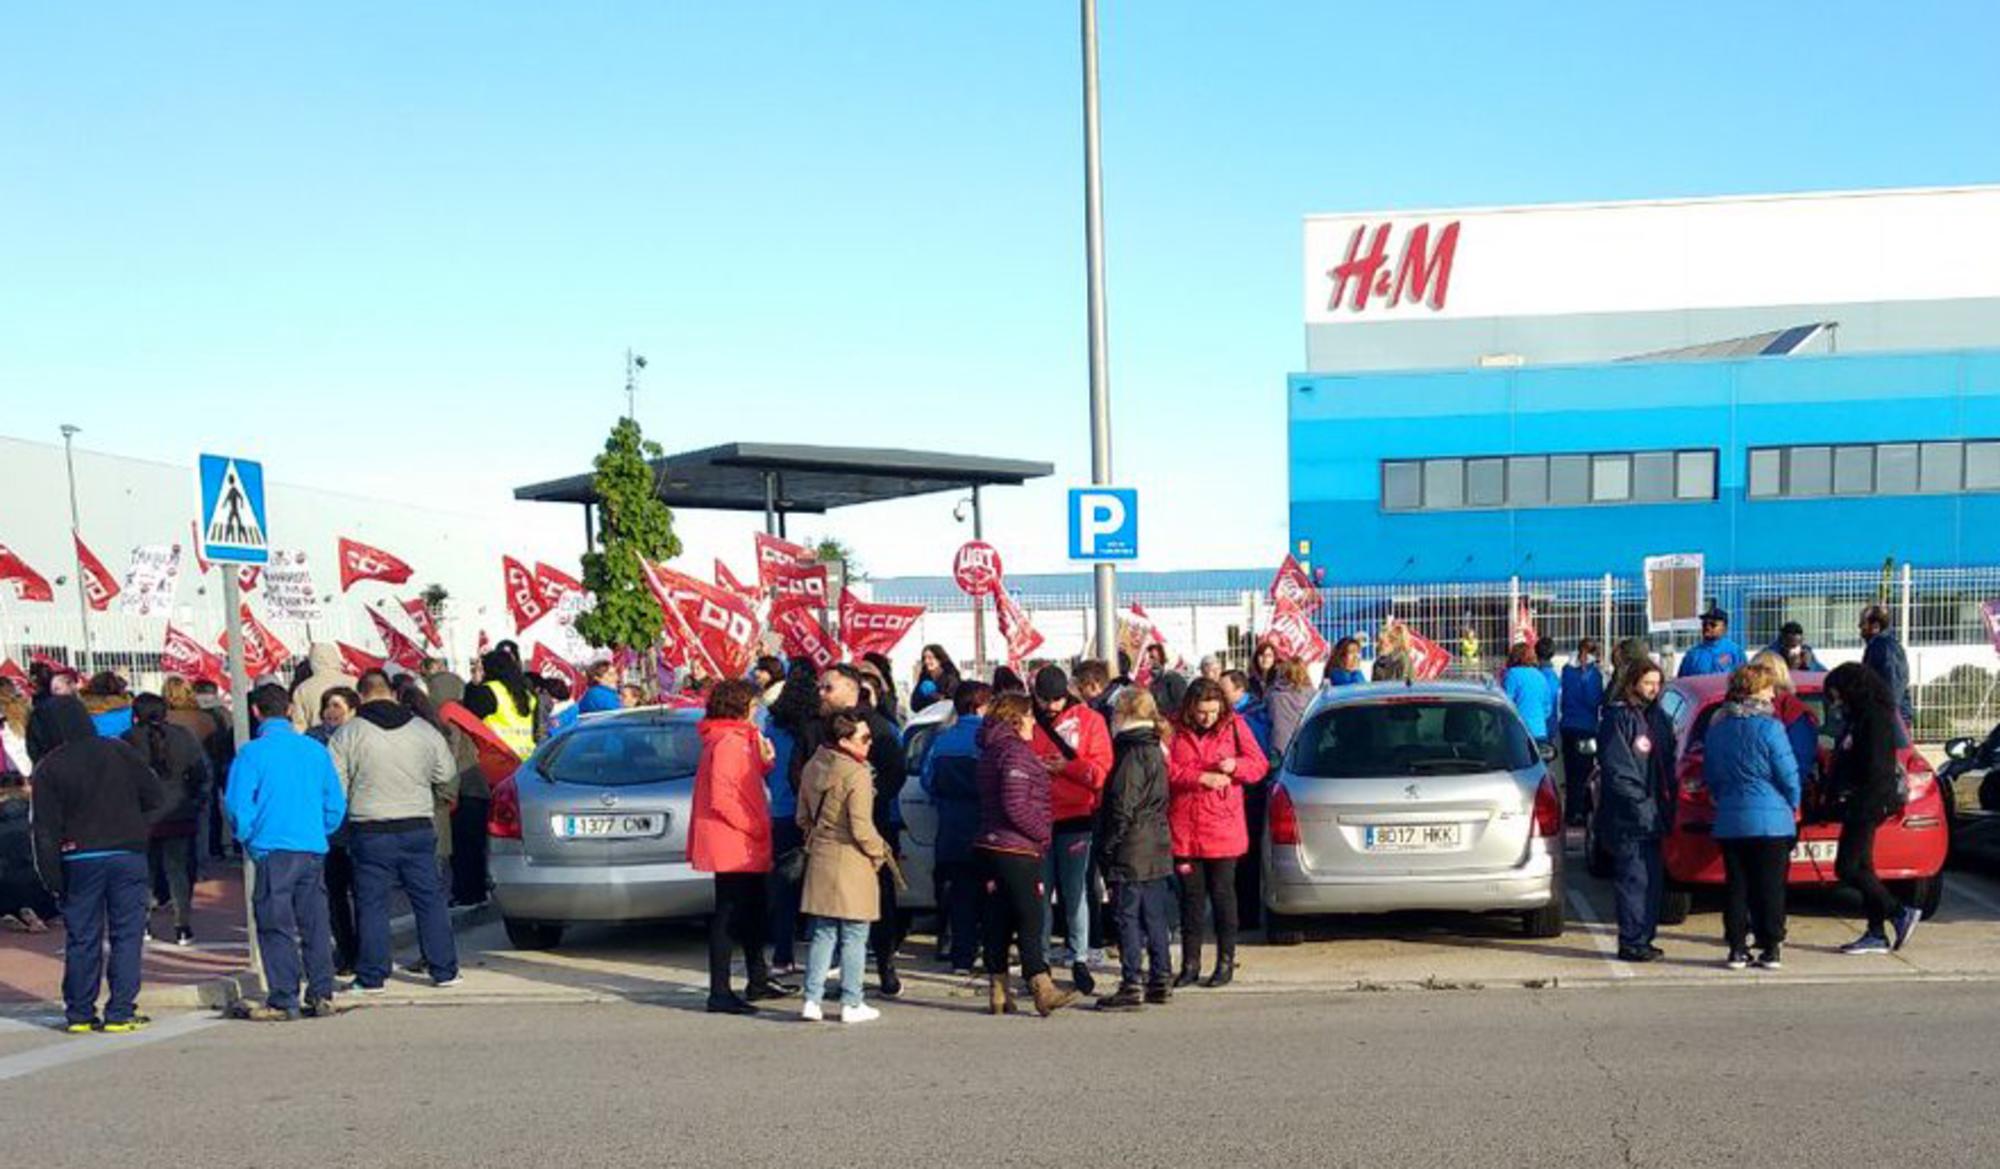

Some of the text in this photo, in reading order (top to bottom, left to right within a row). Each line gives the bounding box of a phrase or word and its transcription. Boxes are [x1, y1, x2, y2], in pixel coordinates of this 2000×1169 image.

[1327, 221, 1461, 311] H&M
[1081, 495, 1125, 554] P
[960, 546, 996, 569] UGT
[1376, 827, 1453, 843] 8017 HKK
